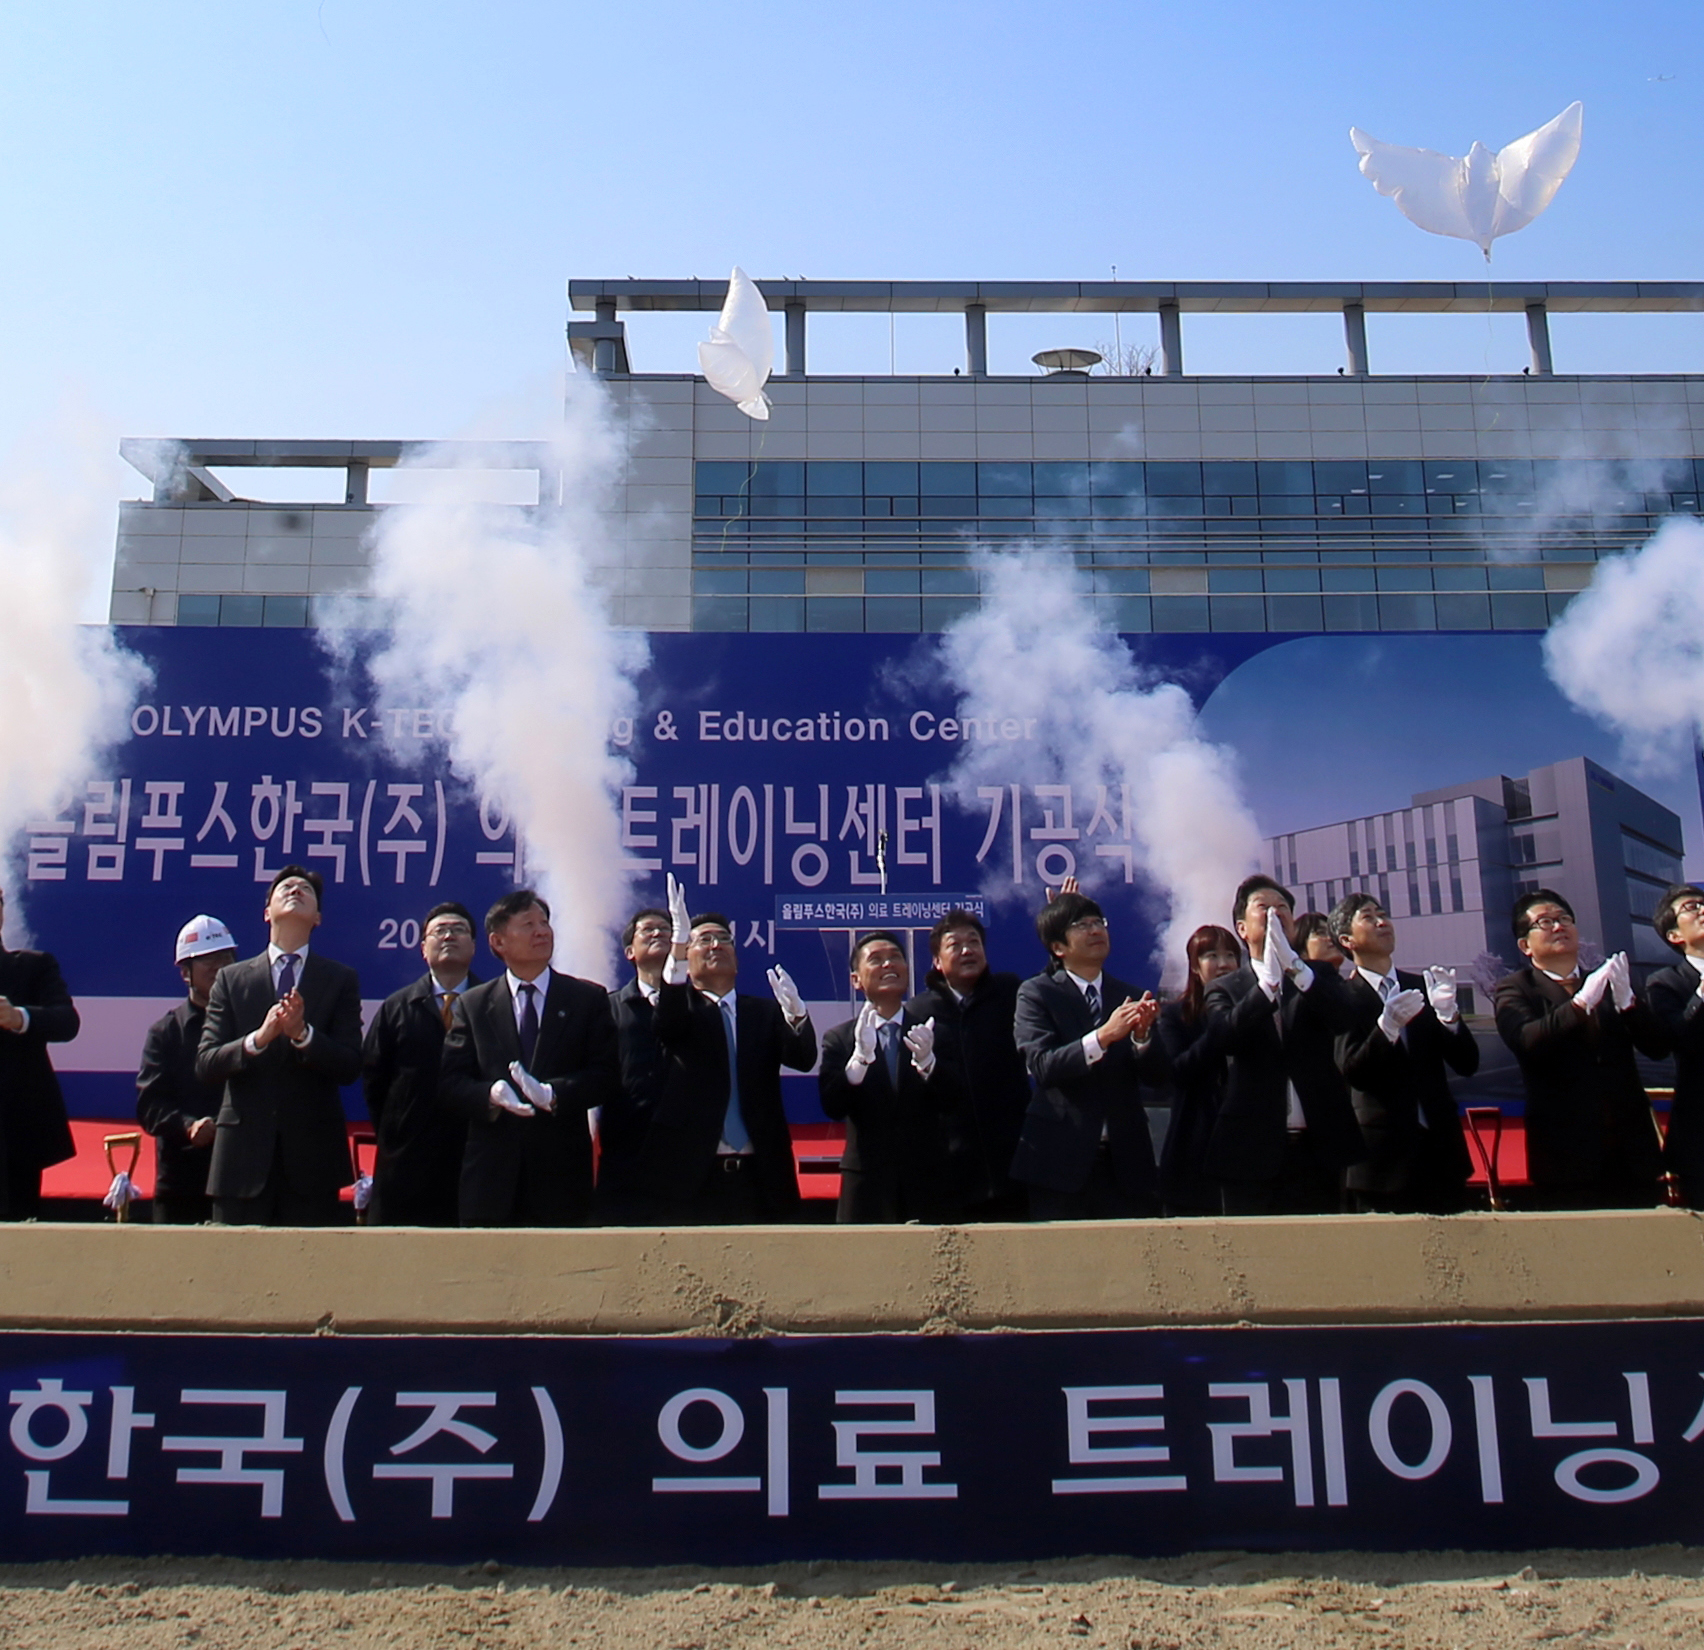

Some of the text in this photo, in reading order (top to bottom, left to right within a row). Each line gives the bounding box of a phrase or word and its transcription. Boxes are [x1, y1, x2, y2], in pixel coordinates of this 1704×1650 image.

[130, 704, 322, 738] OLYMPUS
[653, 710, 680, 742] &
[699, 710, 890, 742] Education
[909, 710, 1039, 742] Center
[620, 784, 942, 887] 트레이닝센터
[975, 783, 1134, 886] 기공식
[781, 902, 864, 920] 올림푸스한국(주)
[868, 901, 889, 919] 의료
[892, 901, 951, 919] 트레이닝센터
[378, 918, 421, 949] 20
[651, 1387, 959, 1517] 의료
